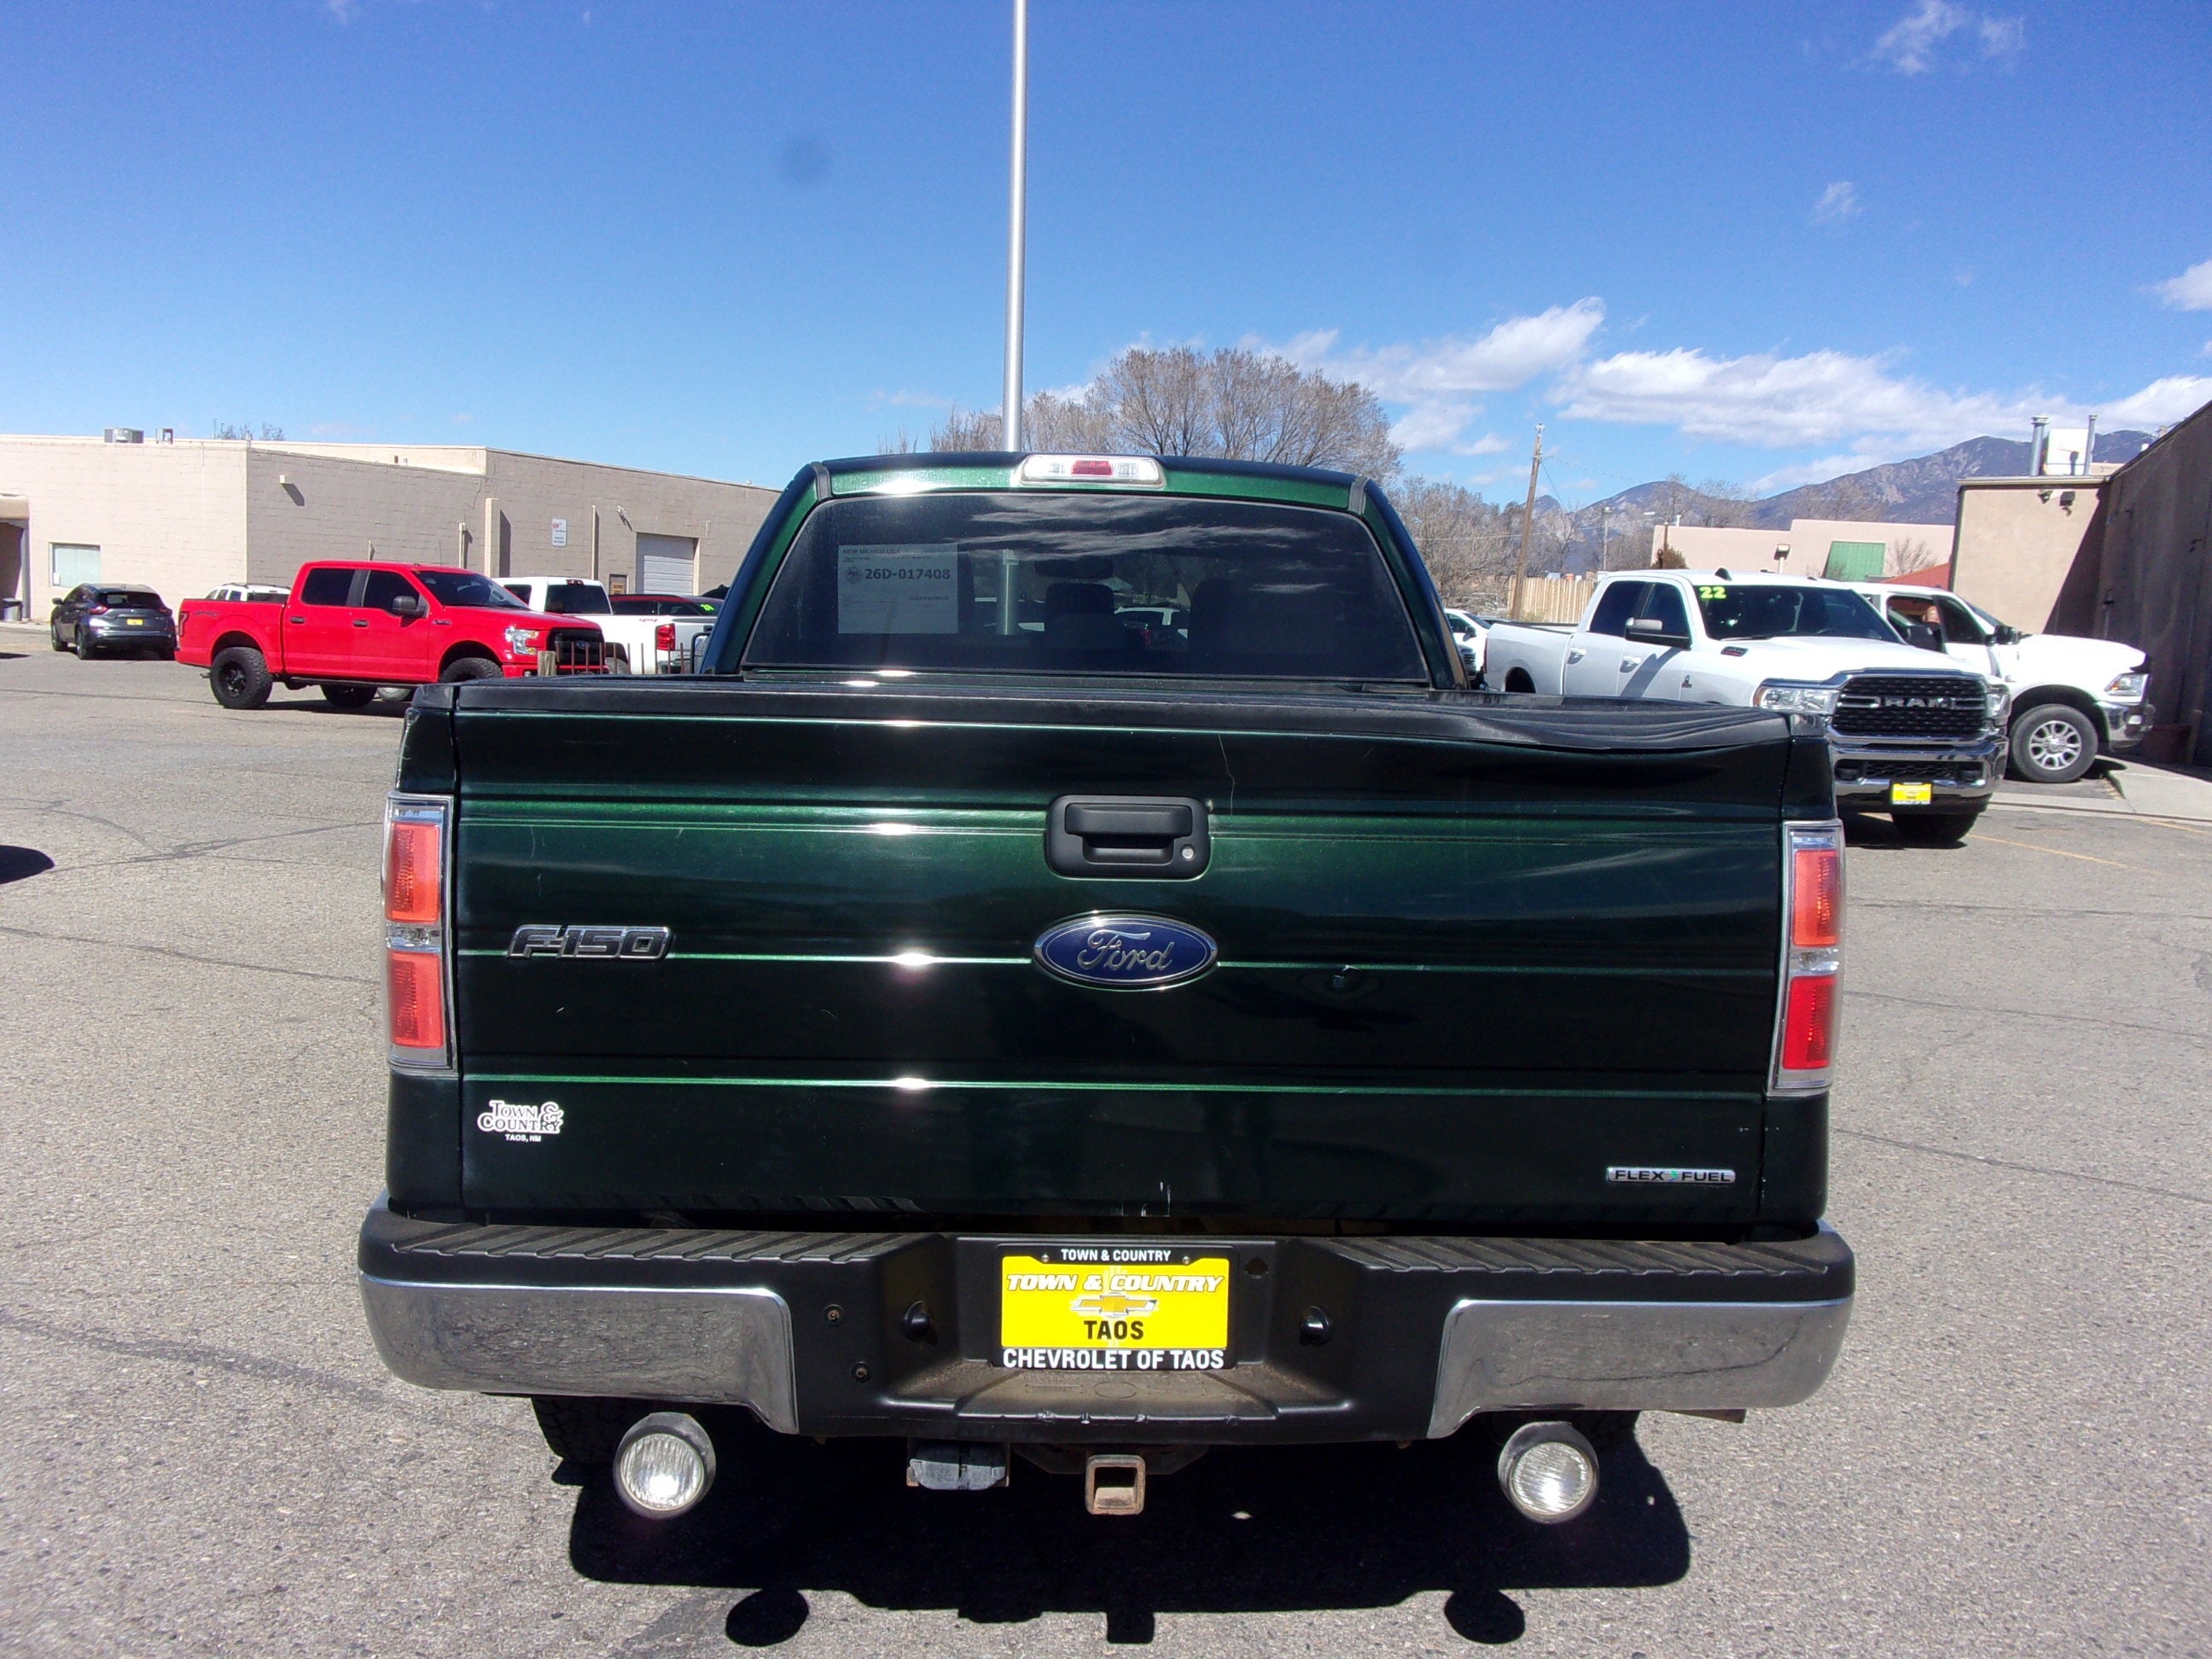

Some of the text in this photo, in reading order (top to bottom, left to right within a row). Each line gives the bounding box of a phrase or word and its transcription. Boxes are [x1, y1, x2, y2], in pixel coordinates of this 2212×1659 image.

[864, 568, 951, 579] 26D-017408
[1699, 586, 1727, 599] 22
[1884, 697, 1953, 707] RAM
[507, 924, 672, 961] F-150
[1077, 929, 1174, 970] Ford
[505, 1134, 529, 1143] TAOS,
[1615, 1170, 1731, 1182] FLEX FUEL
[1061, 1249, 1172, 1262] TOWN & COUNTRY
[1006, 1274, 1225, 1292] TOWN & COUNTRY
[1084, 1320, 1144, 1340] TAOS
[1003, 1348, 1225, 1370] CHEVROLET OF TAOS
